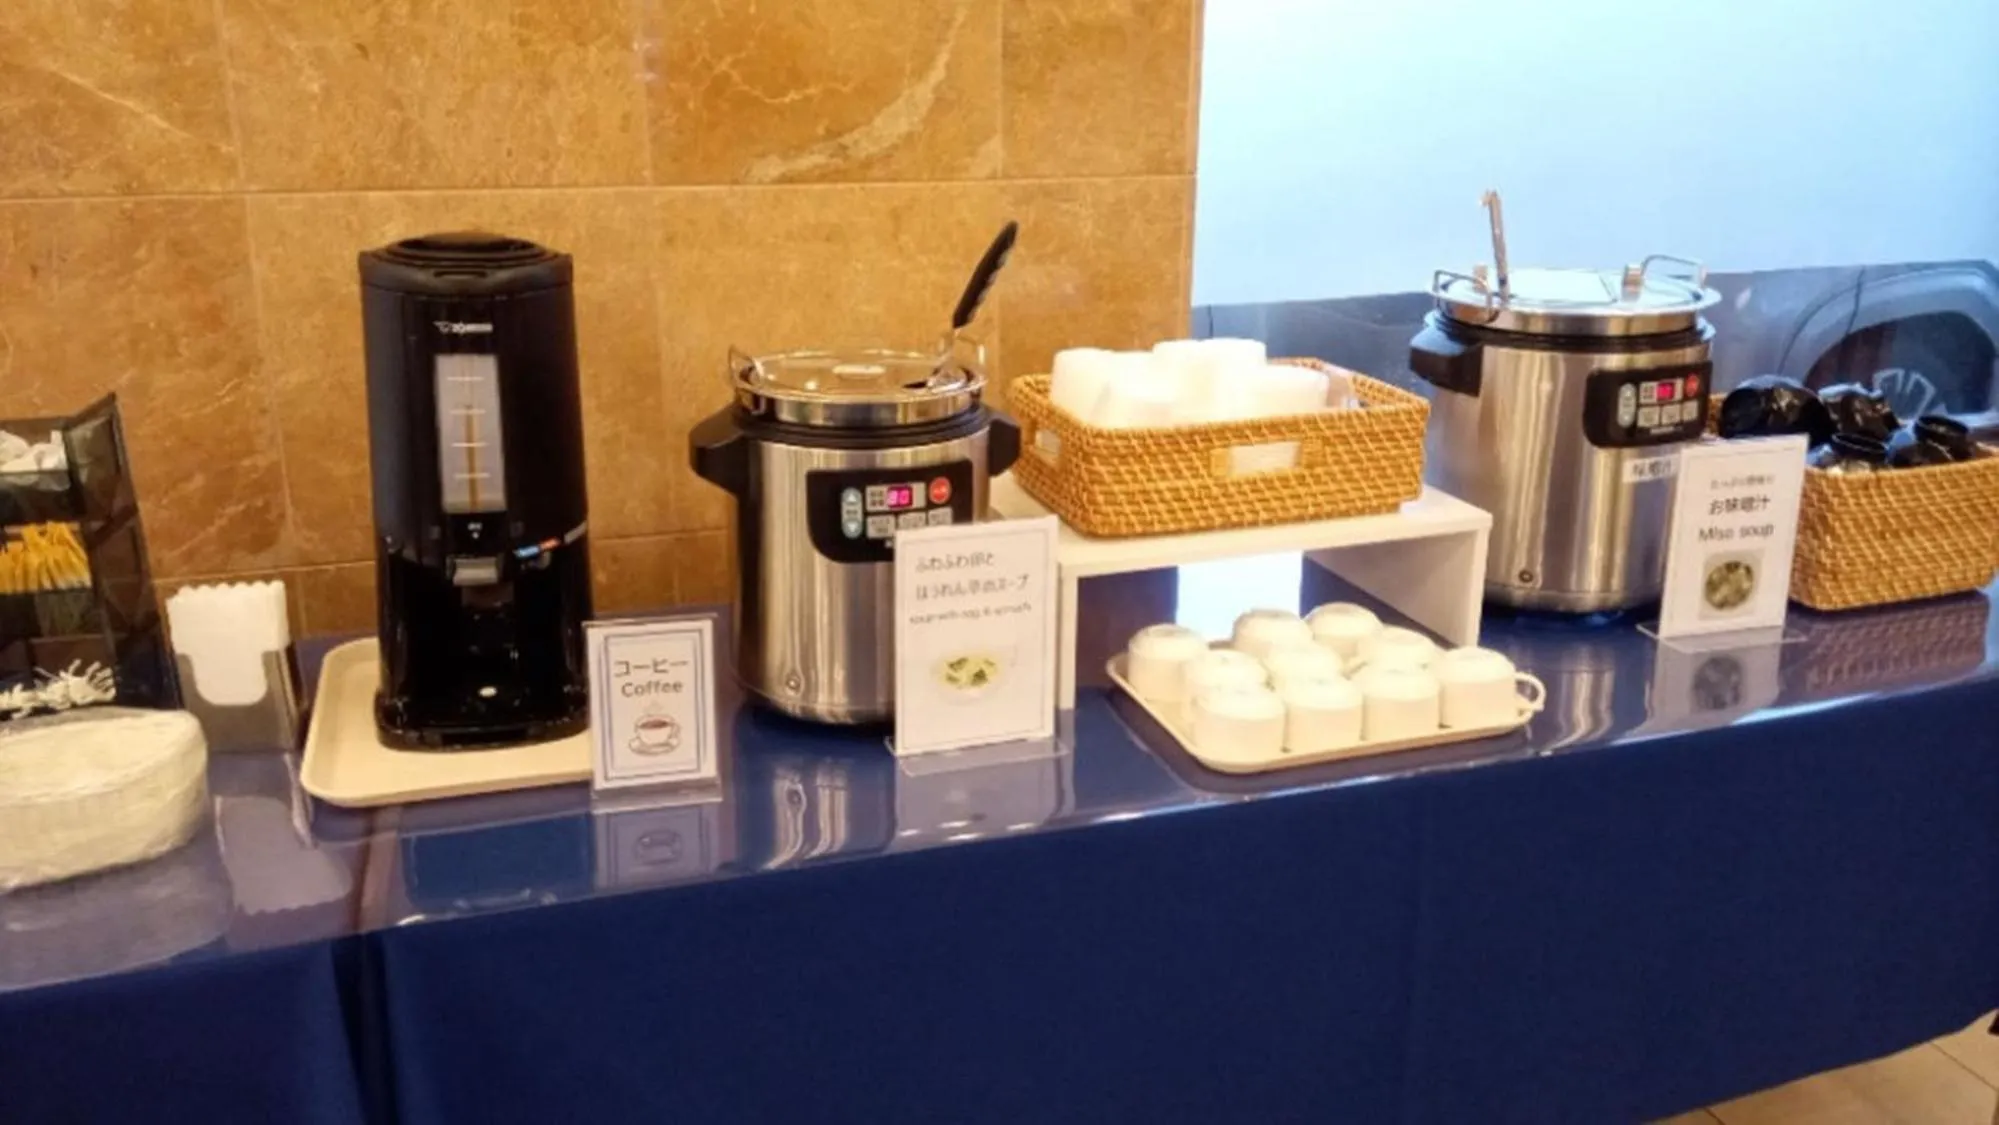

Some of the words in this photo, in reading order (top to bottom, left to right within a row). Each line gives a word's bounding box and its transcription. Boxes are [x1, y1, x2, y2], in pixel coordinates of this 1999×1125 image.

[1699, 526, 1734, 541] Miso
[1739, 524, 1775, 540] soup
[613, 658, 688, 678] コーヒー
[621, 680, 684, 698] Coffee
